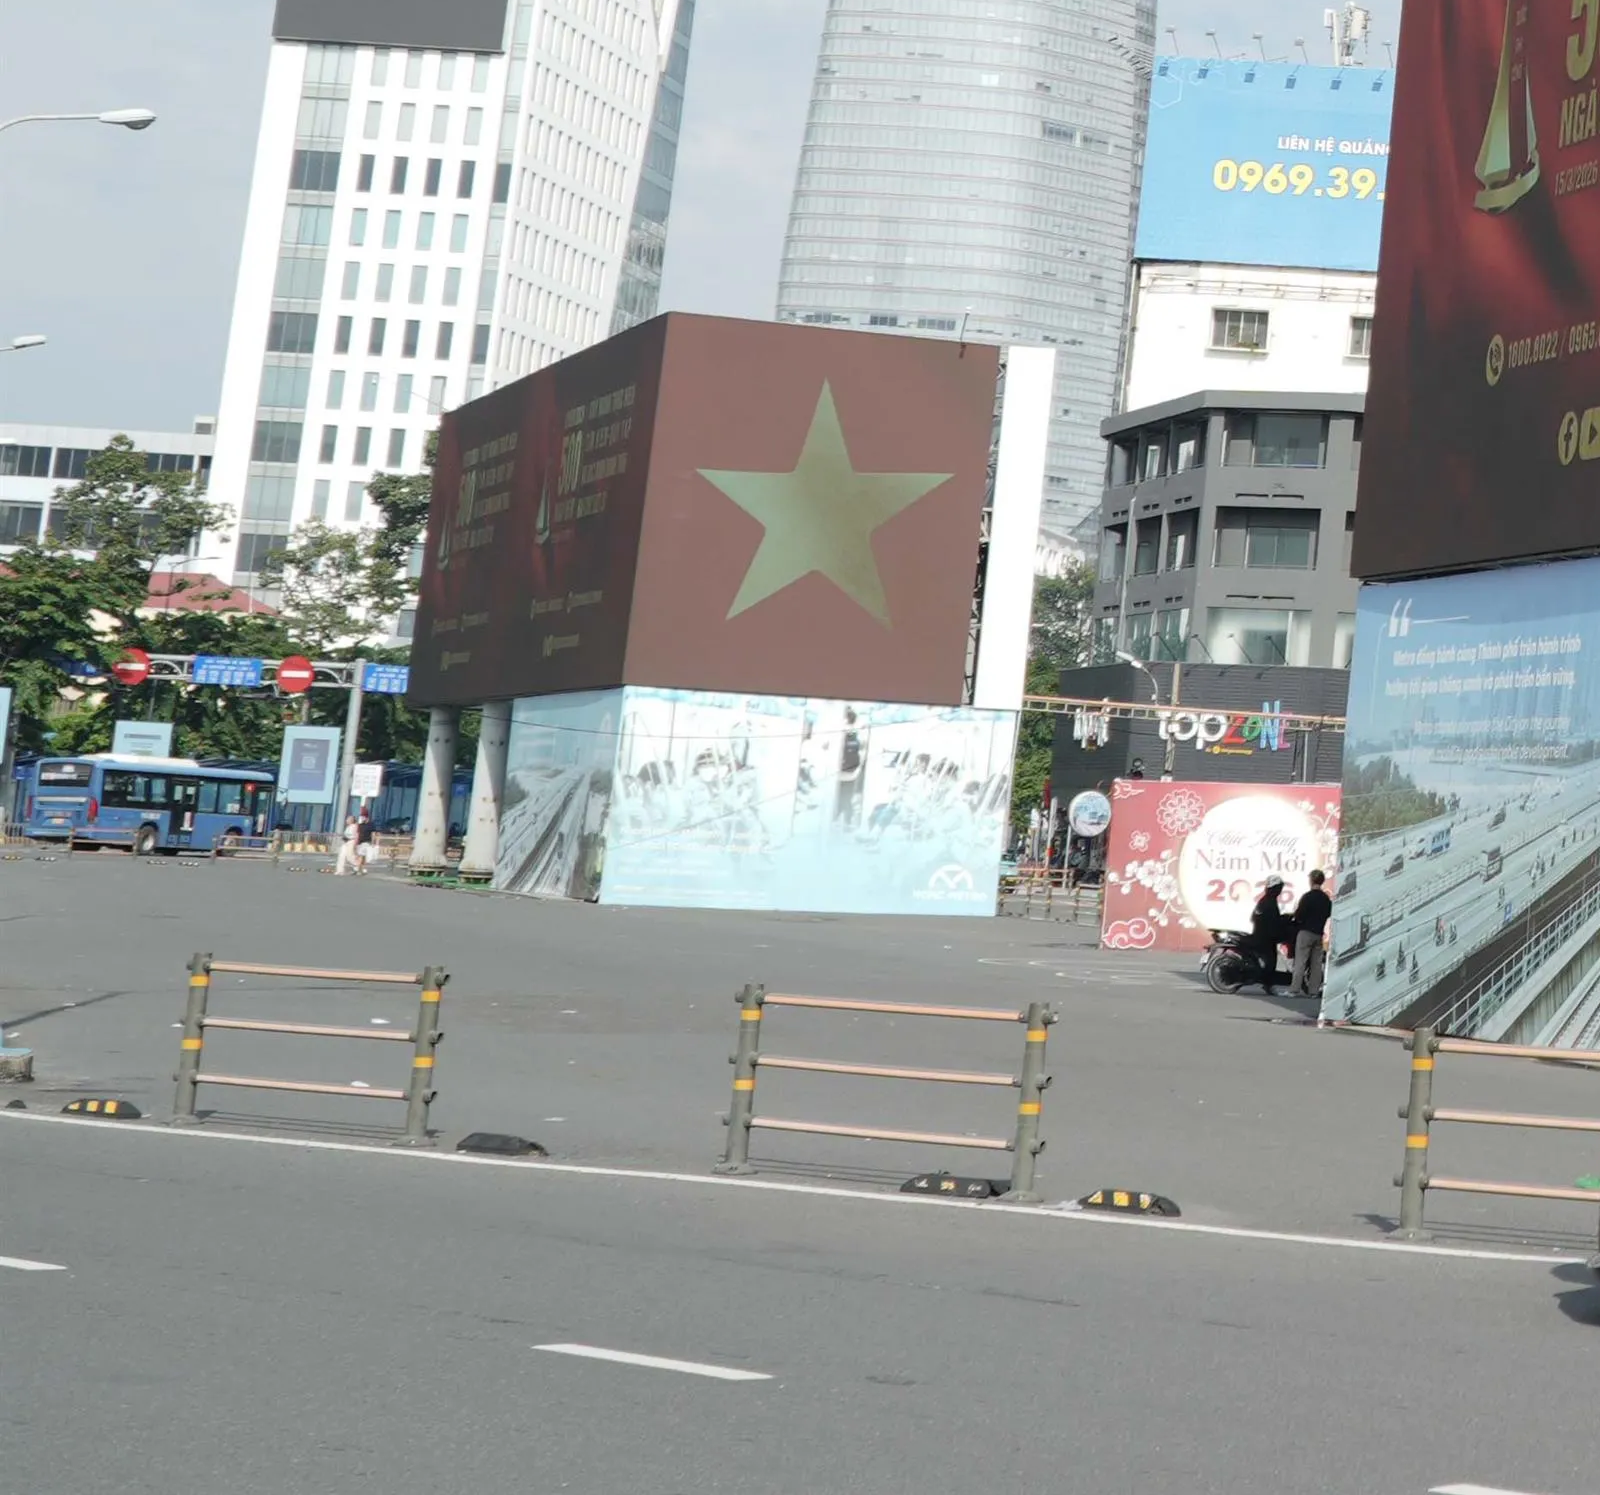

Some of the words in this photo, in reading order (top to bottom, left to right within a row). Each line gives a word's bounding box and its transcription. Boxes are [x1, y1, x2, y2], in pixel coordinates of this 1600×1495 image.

[1277, 134, 1310, 152] LIÊN
[1315, 136, 1335, 156] HỆ
[1339, 137, 1390, 156] QUẢN
[1212, 159, 1387, 202] 0969.39.
[1194, 848, 1250, 870] Năm
[1259, 850, 1306, 872] Mới
